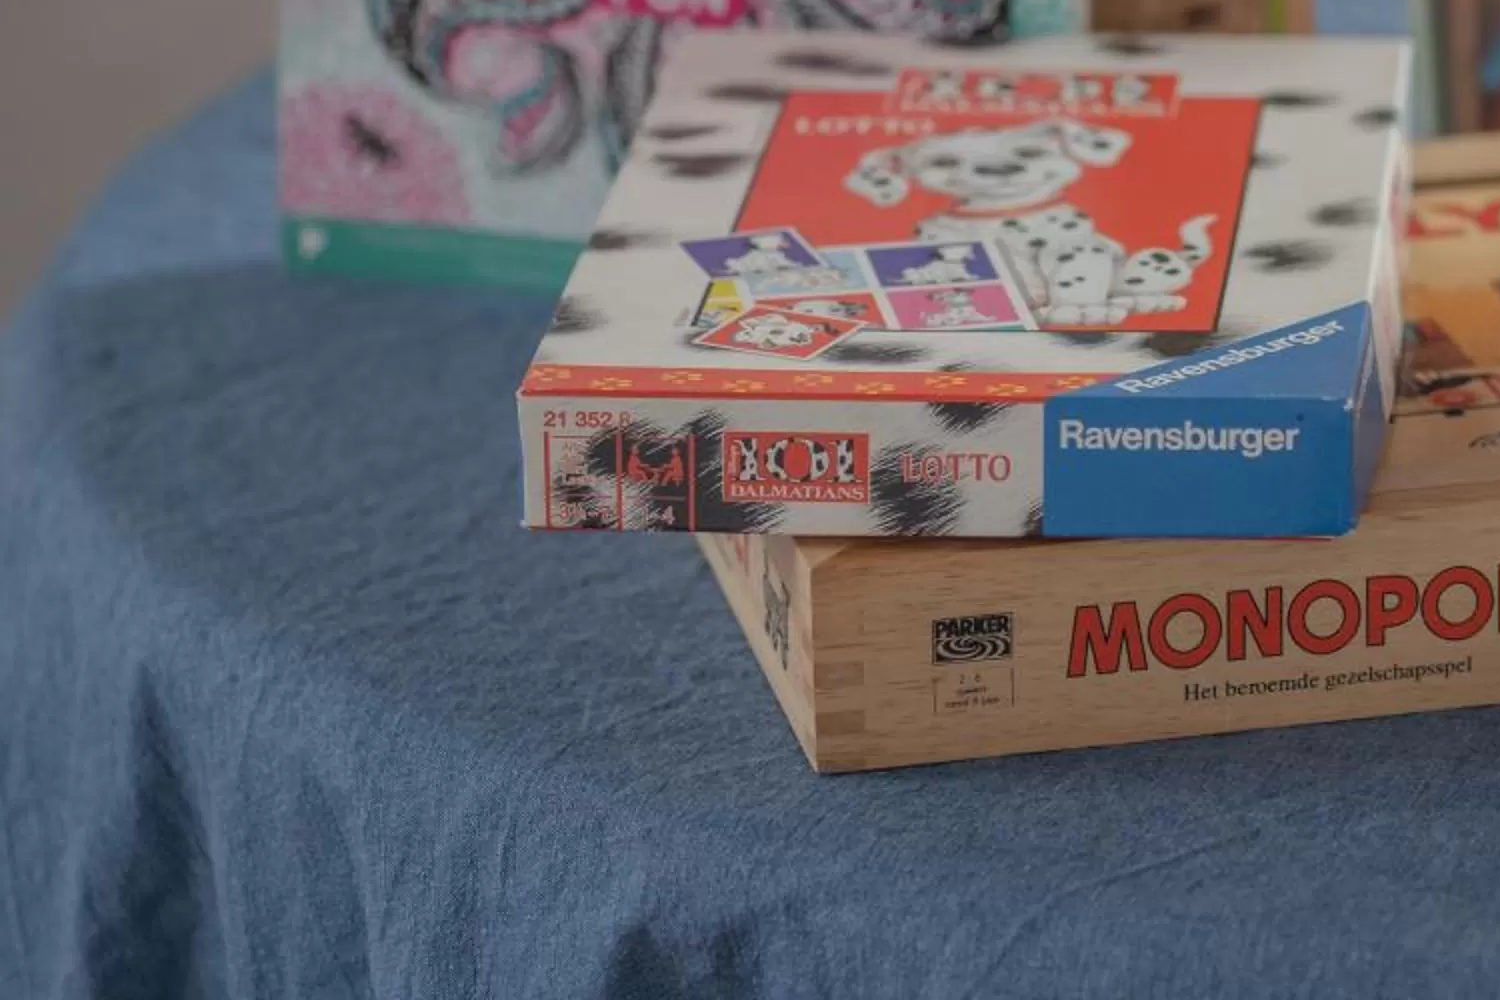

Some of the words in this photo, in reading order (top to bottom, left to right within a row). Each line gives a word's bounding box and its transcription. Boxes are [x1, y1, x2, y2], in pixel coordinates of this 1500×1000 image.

[1114, 319, 1346, 394] Ravensburger
[543, 411, 567, 428] 21
[575, 411, 613, 428] 352
[1058, 419, 1300, 459] Ravensburger
[902, 452, 1012, 485] LOTTO
[730, 482, 865, 502] DALMATIANS
[935, 614, 1009, 638] PARKER
[1183, 682, 1220, 702] Het
[1224, 672, 1320, 699] beroemde
[1323, 655, 1473, 694] gezelschapsspel
